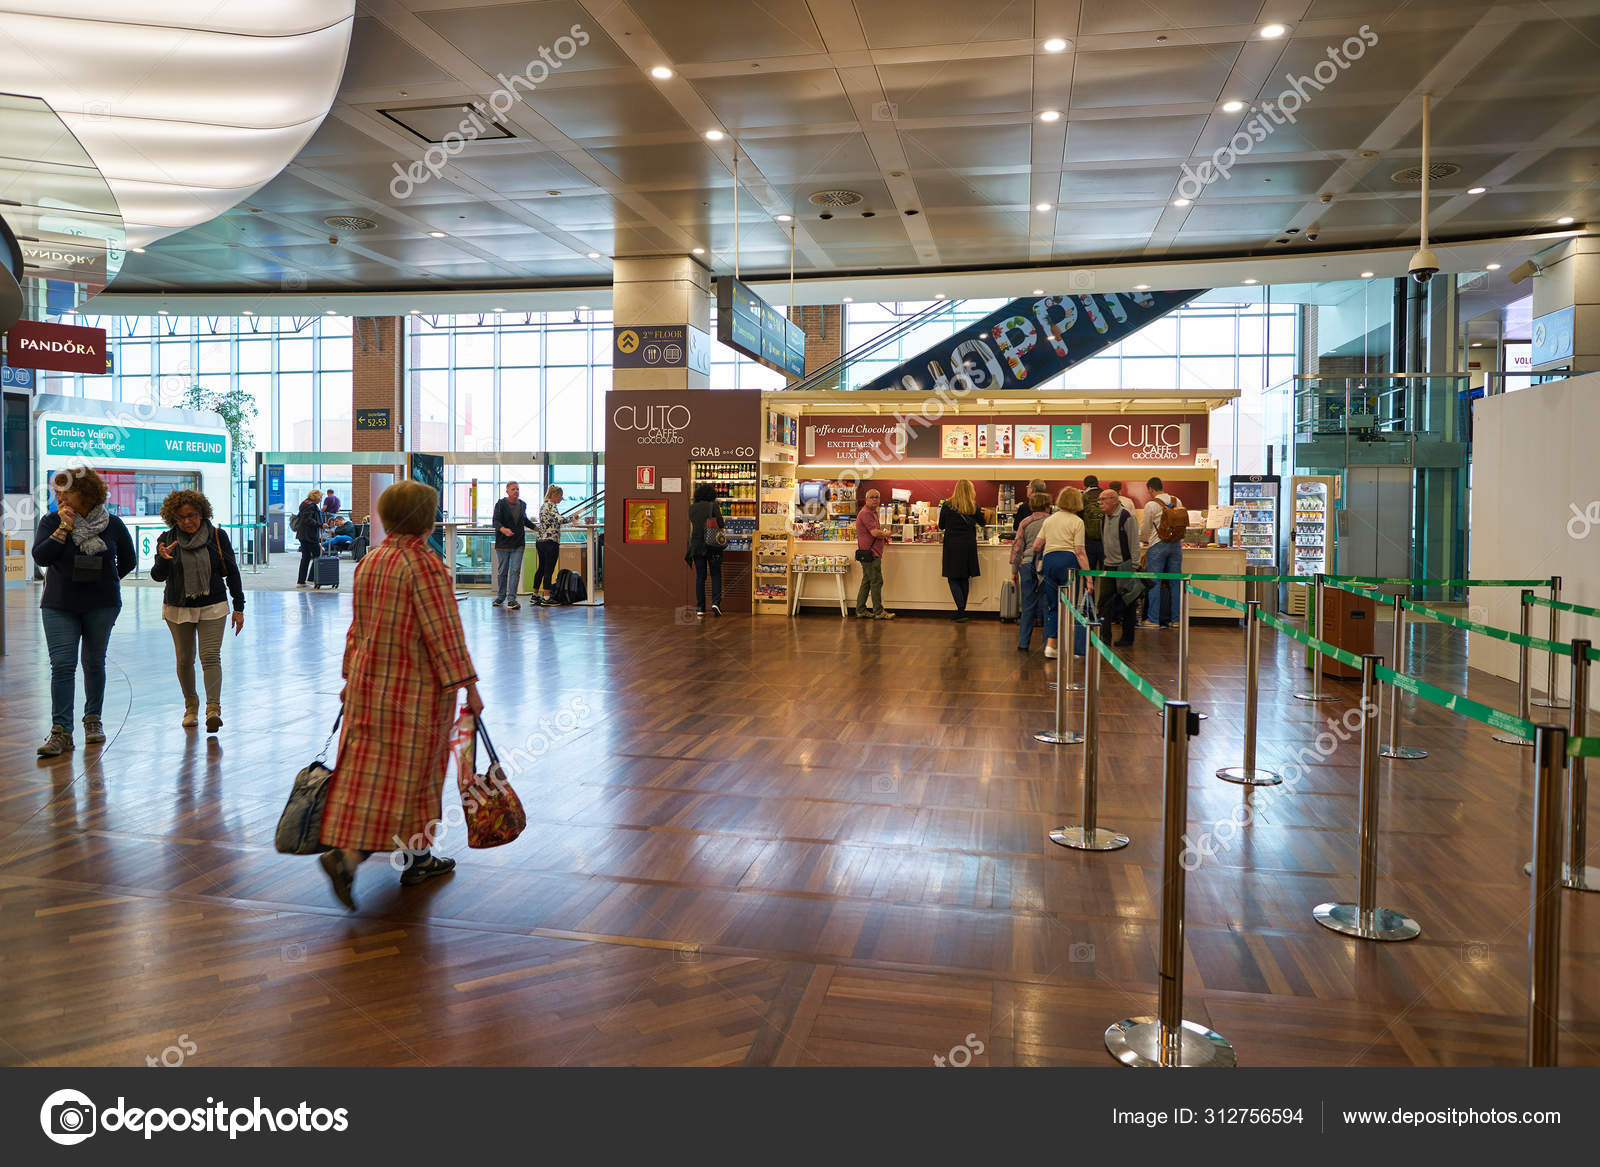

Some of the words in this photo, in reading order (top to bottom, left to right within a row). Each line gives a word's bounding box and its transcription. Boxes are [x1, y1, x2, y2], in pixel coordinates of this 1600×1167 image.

[654, 330, 683, 339] FLOOR
[20, 337, 97, 356] PANDORA
[1514, 356, 1532, 365] VOL
[367, 418, 387, 427] 52-53
[613, 404, 691, 431] CULTO
[50, 426, 86, 438] Cambio
[87, 429, 114, 440] Valute
[837, 424, 855, 434] and
[1108, 424, 1181, 447] CULTO
[50, 437, 87, 451] Currency
[89, 439, 125, 452] Exchange
[165, 439, 184, 451] VAT
[186, 440, 223, 453] REFUND
[827, 440, 881, 448] EXCITEMENT
[691, 446, 720, 457] GRAB
[735, 446, 755, 457] GO
[836, 451, 870, 459] LUXURY
